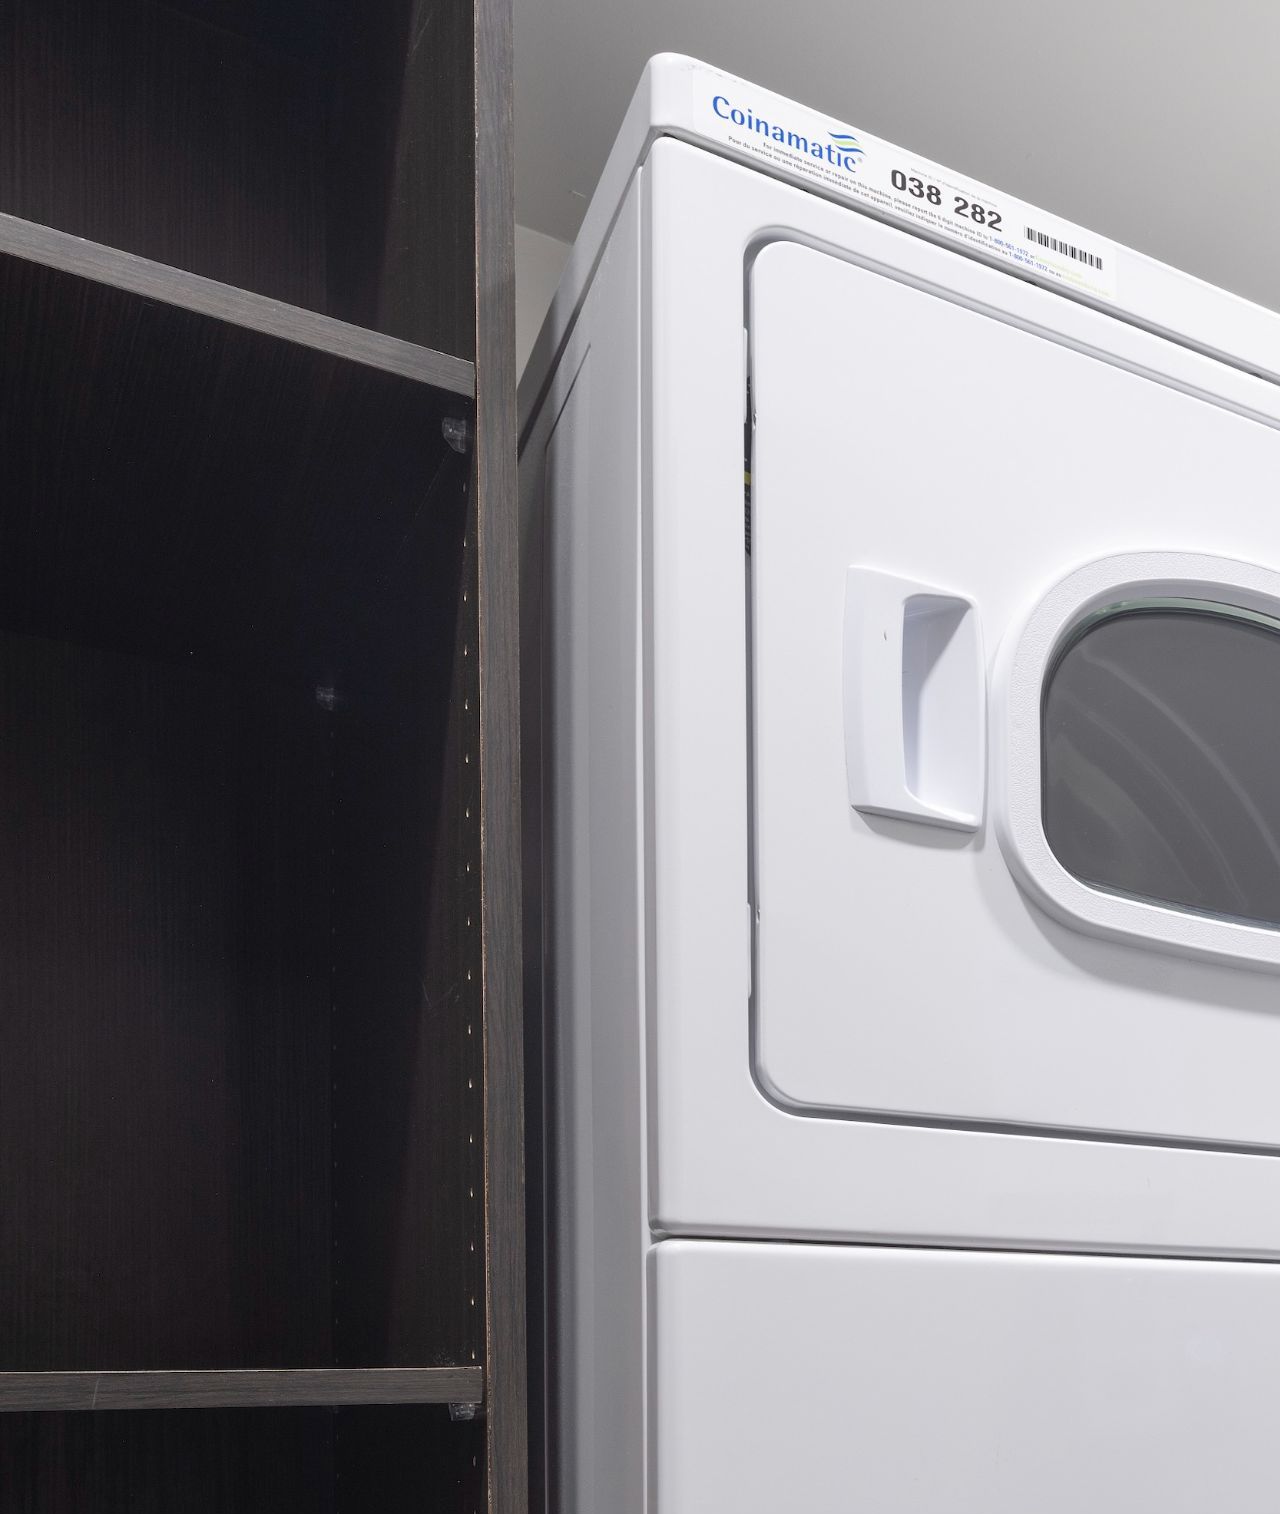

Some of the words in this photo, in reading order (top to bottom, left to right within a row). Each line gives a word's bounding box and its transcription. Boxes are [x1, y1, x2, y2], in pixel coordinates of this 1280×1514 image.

[712, 95, 857, 173] Coinamatic
[891, 169, 942, 206] 038
[954, 196, 1003, 232] 282
